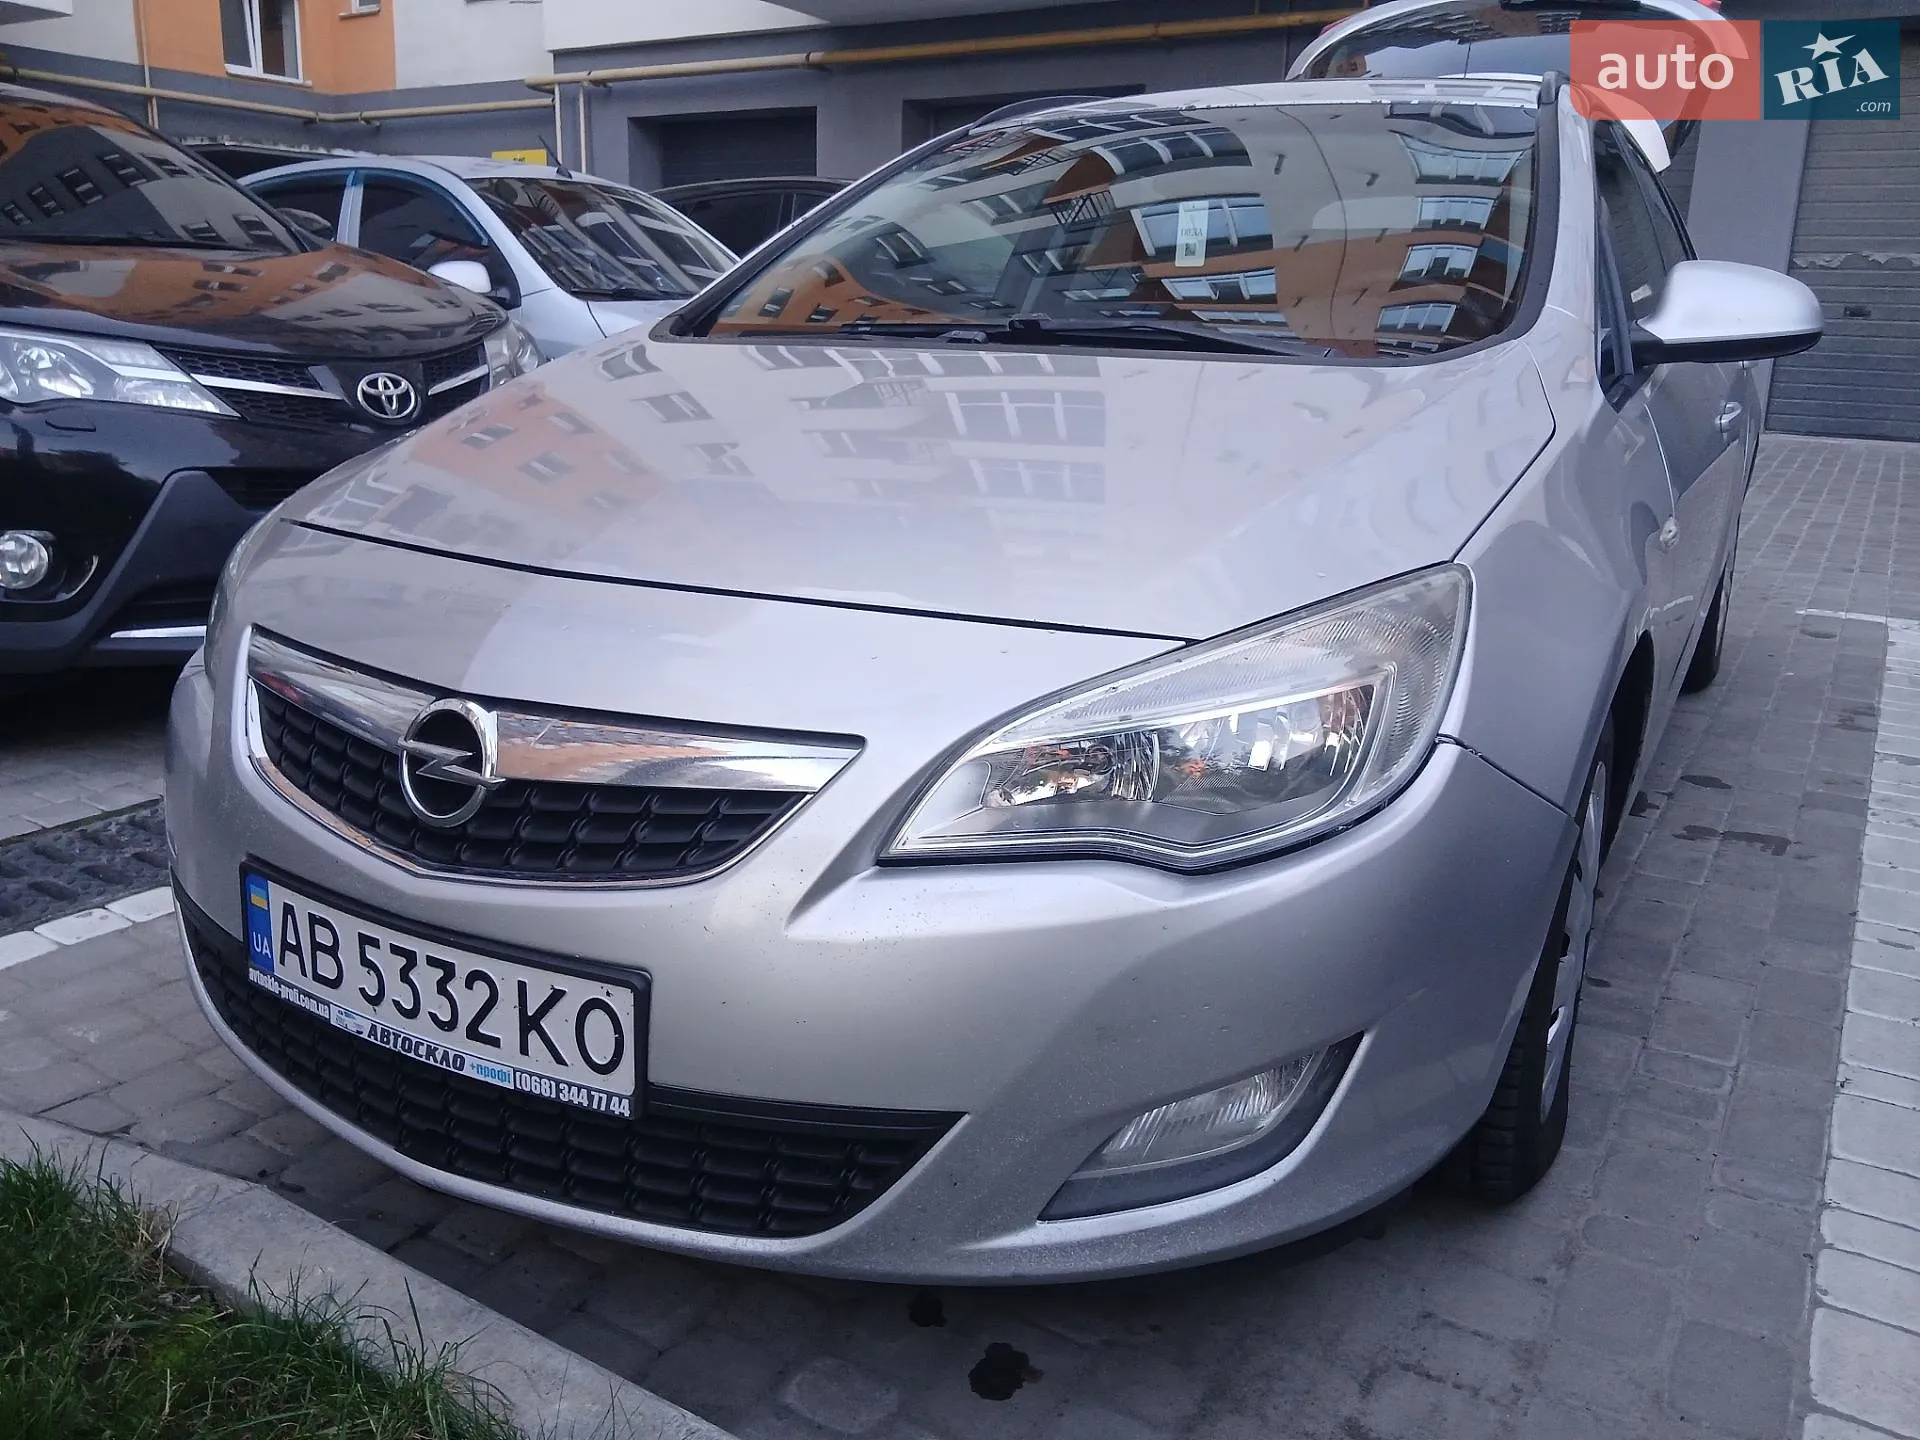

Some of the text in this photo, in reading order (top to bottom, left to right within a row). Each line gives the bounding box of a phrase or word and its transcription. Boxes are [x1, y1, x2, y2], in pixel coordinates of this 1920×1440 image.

[252, 931, 272, 960] UA
[279, 901, 625, 1076] AB 5332 KO
[367, 1022, 466, 1072] АВТОСКЛО
[515, 1071, 631, 1117] (068) 344 77 44
